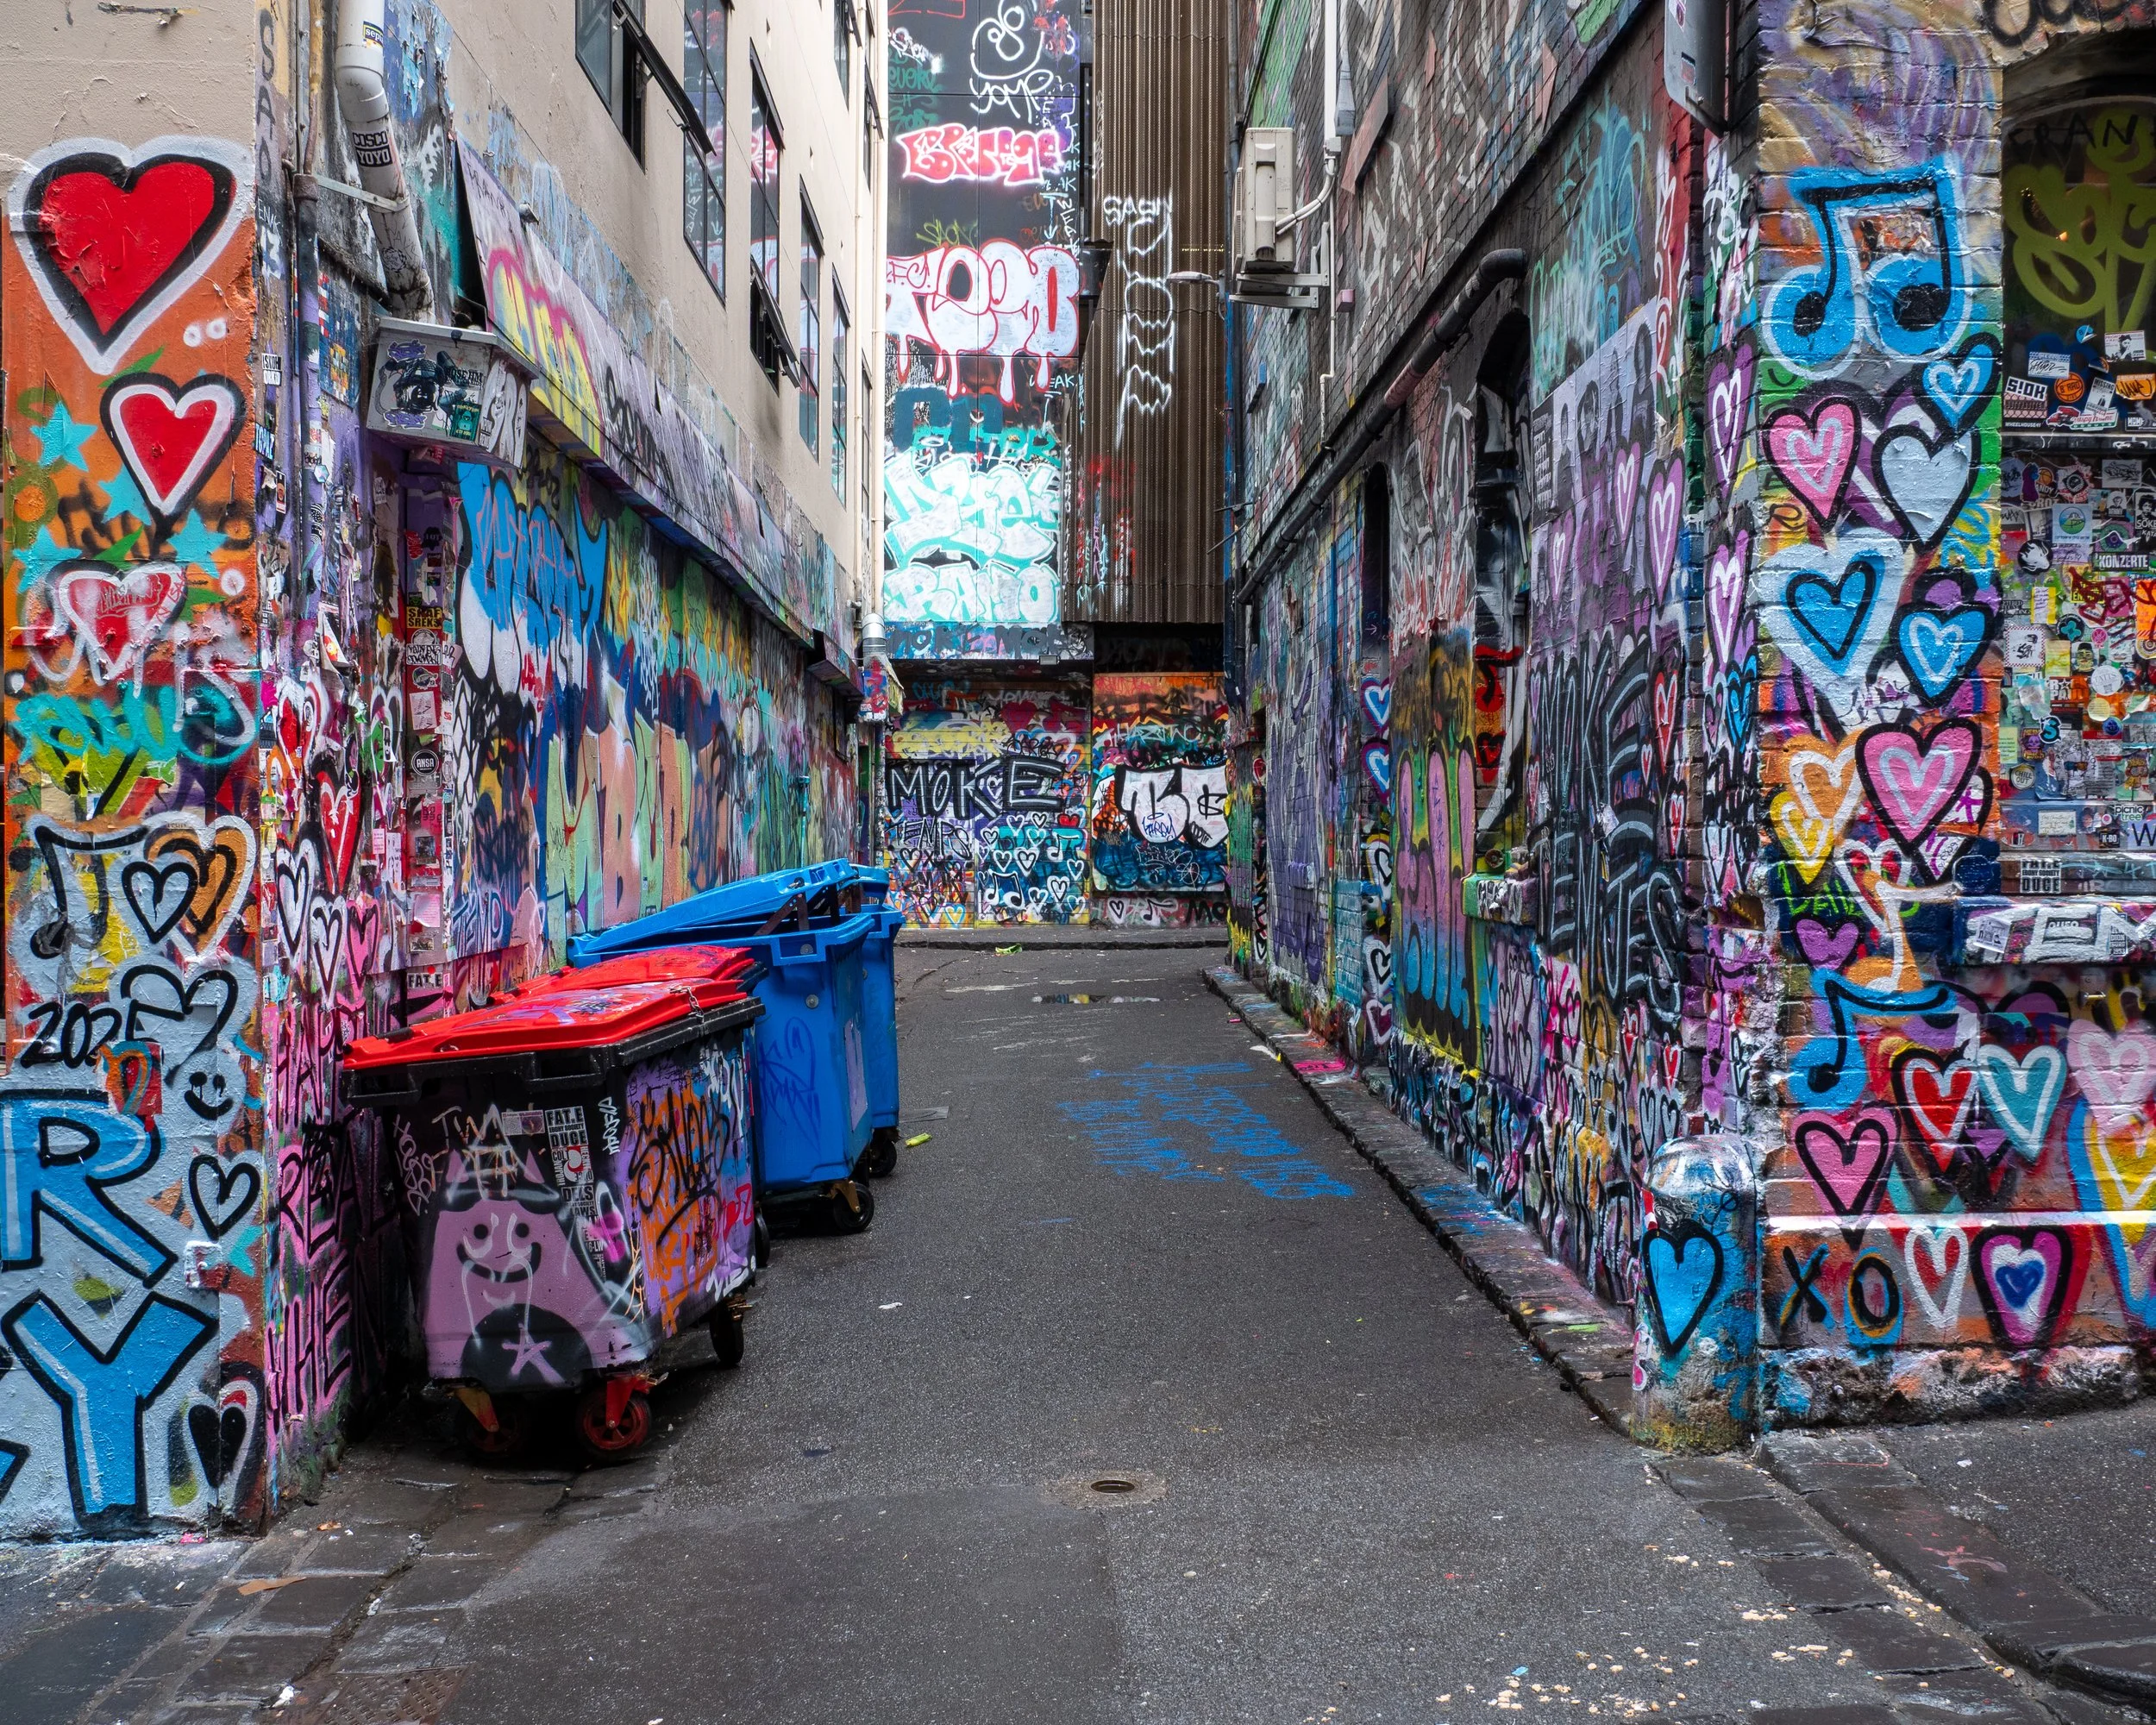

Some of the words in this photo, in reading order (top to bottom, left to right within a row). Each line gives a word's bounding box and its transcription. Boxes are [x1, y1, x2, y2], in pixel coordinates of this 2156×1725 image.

[357, 148, 391, 167] YOYO
[2094, 378, 2115, 389] MISSING
[417, 758, 435, 768] ANSA
[2015, 770, 2033, 780] CHILL
[887, 756, 1069, 819] MOKE
[2115, 805, 2144, 815] picnic
[2122, 812, 2142, 821] tree
[2022, 877, 2060, 893] DUCE
[547, 1107, 585, 1125] FAT.E
[552, 1130, 588, 1147] DUCE
